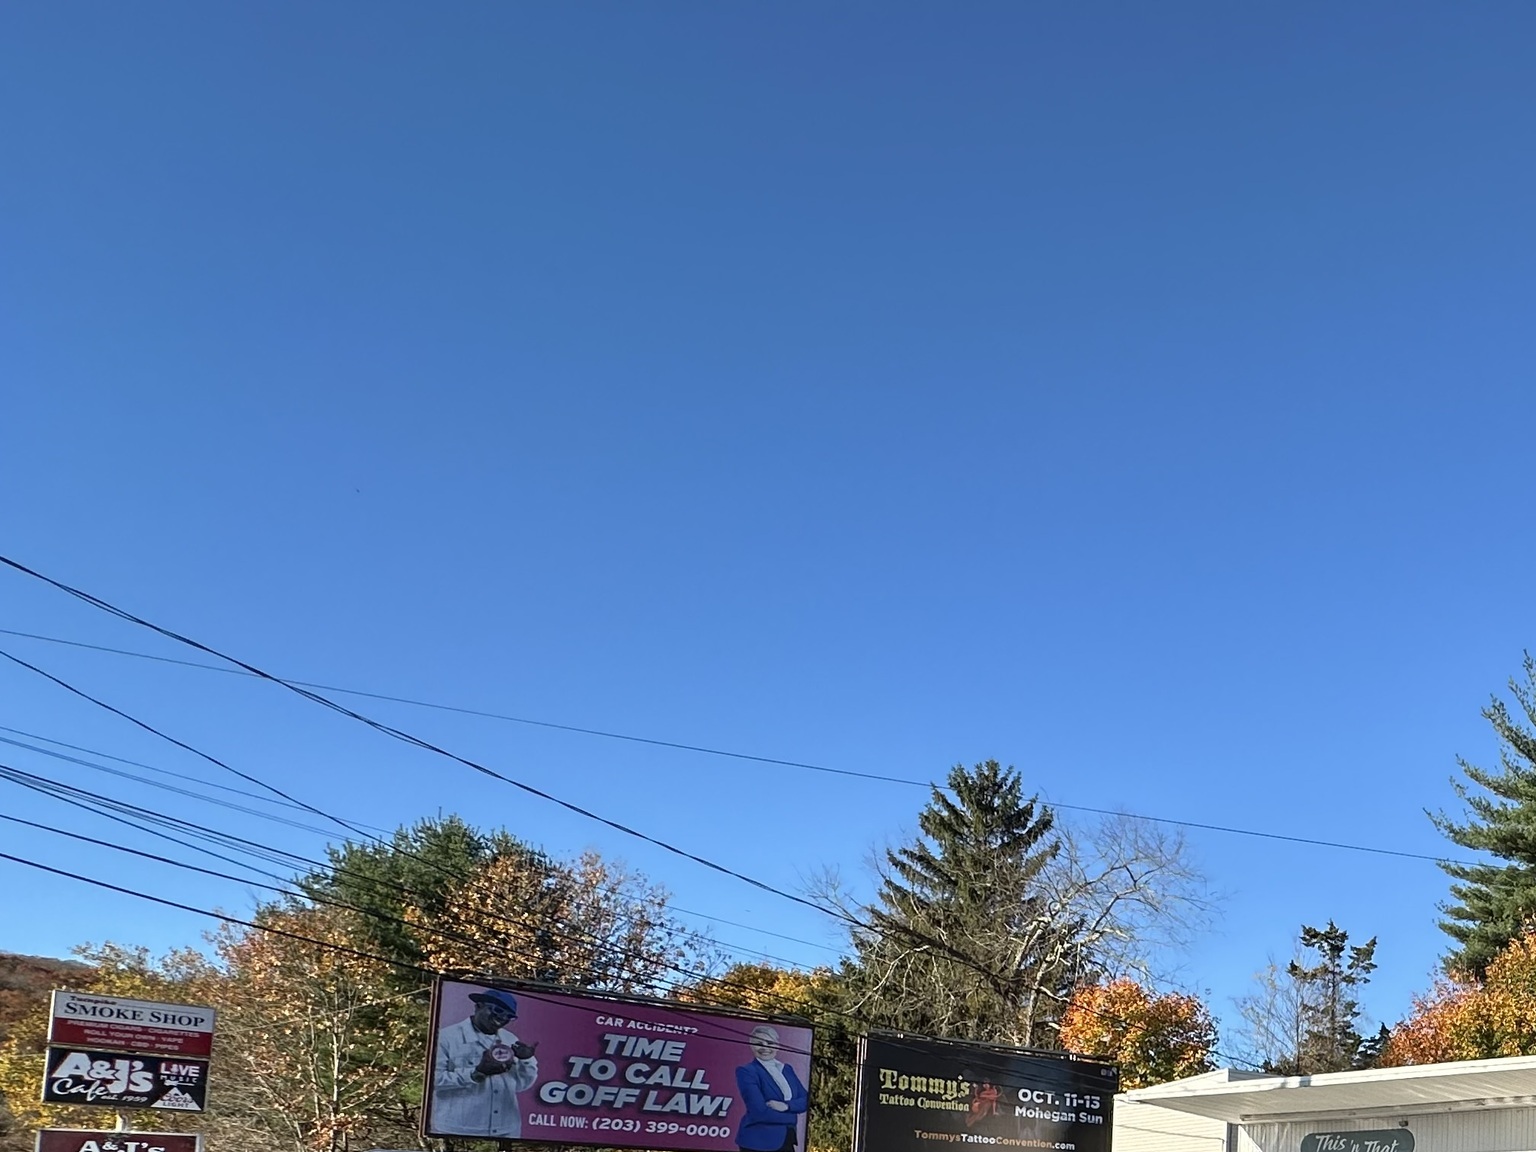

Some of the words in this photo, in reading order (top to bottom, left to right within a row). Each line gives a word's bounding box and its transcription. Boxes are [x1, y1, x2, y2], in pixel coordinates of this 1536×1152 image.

[64, 1002, 144, 1021] SMOKE
[149, 1010, 205, 1027] SHOP
[596, 1016, 624, 1027] CAR
[627, 1020, 698, 1035] ACCIDENT?
[84, 1029, 107, 1037] ROLL
[109, 1031, 133, 1039] YOUR
[135, 1033, 156, 1041] OWN
[161, 1036, 184, 1044] VAPE
[110, 1023, 143, 1032] CIGARS
[148, 1027, 200, 1038] CIGARETTES
[155, 1043, 179, 1051] PIPES
[604, 1033, 687, 1062] TIME
[52, 1052, 154, 1094] A&J's
[160, 1062, 200, 1077] LIVE
[567, 1056, 617, 1081] TO
[624, 1062, 711, 1091] CALL
[879, 1068, 971, 1100] Tommy's
[539, 1081, 640, 1109] GOFF
[642, 1089, 733, 1118] LAW!
[879, 1093, 915, 1107] Tattoo
[917, 1097, 970, 1112] Convention
[1017, 1088, 1060, 1106] OCT.
[1064, 1092, 1101, 1110] 11-13
[528, 1112, 557, 1128] CALL
[560, 1115, 589, 1129] NOW:
[591, 1117, 641, 1133] (203)
[645, 1120, 731, 1139] 399-0000
[1015, 1106, 1076, 1123] Mohegan
[1079, 1111, 1103, 1125] Sun
[914, 1129, 1075, 1151] TommysTattooConvention.com
[1315, 1134, 1346, 1152] This
